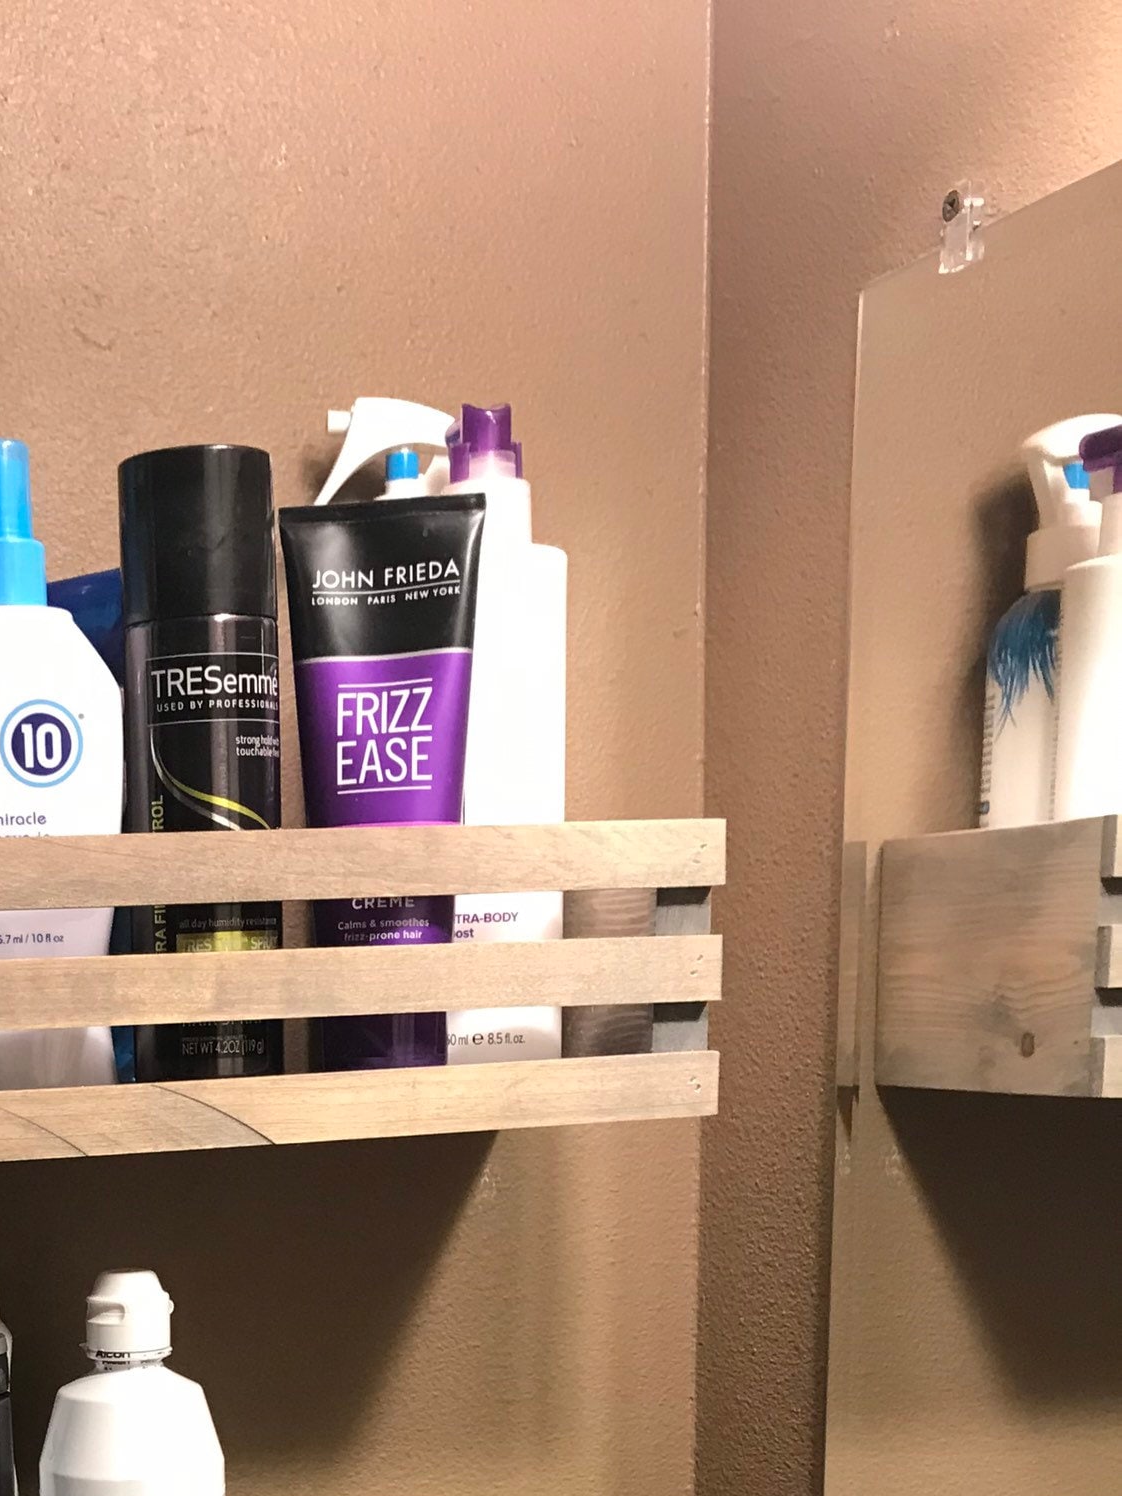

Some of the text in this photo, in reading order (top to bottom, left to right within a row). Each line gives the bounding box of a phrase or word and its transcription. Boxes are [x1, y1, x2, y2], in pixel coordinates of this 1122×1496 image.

[312, 557, 460, 589] JOHN FRIEDA
[311, 585, 461, 606] LONDON PARIS NEW YORK
[150, 665, 278, 698] TRESemmé
[156, 701, 184, 712] USED
[189, 700, 203, 710] BY
[337, 686, 433, 736] FRIZZ
[20, 722, 63, 769] 10
[235, 735, 260, 747] strong
[337, 735, 433, 786] EASE
[337, 917, 430, 930] Calms & smoothes
[454, 911, 519, 924] TRA-BODY
[191, 919, 207, 930] day
[344, 929, 423, 942] frizz-prone hair
[453, 928, 475, 939] ost
[182, 1042, 198, 1055] NET
[200, 1042, 213, 1053] WT
